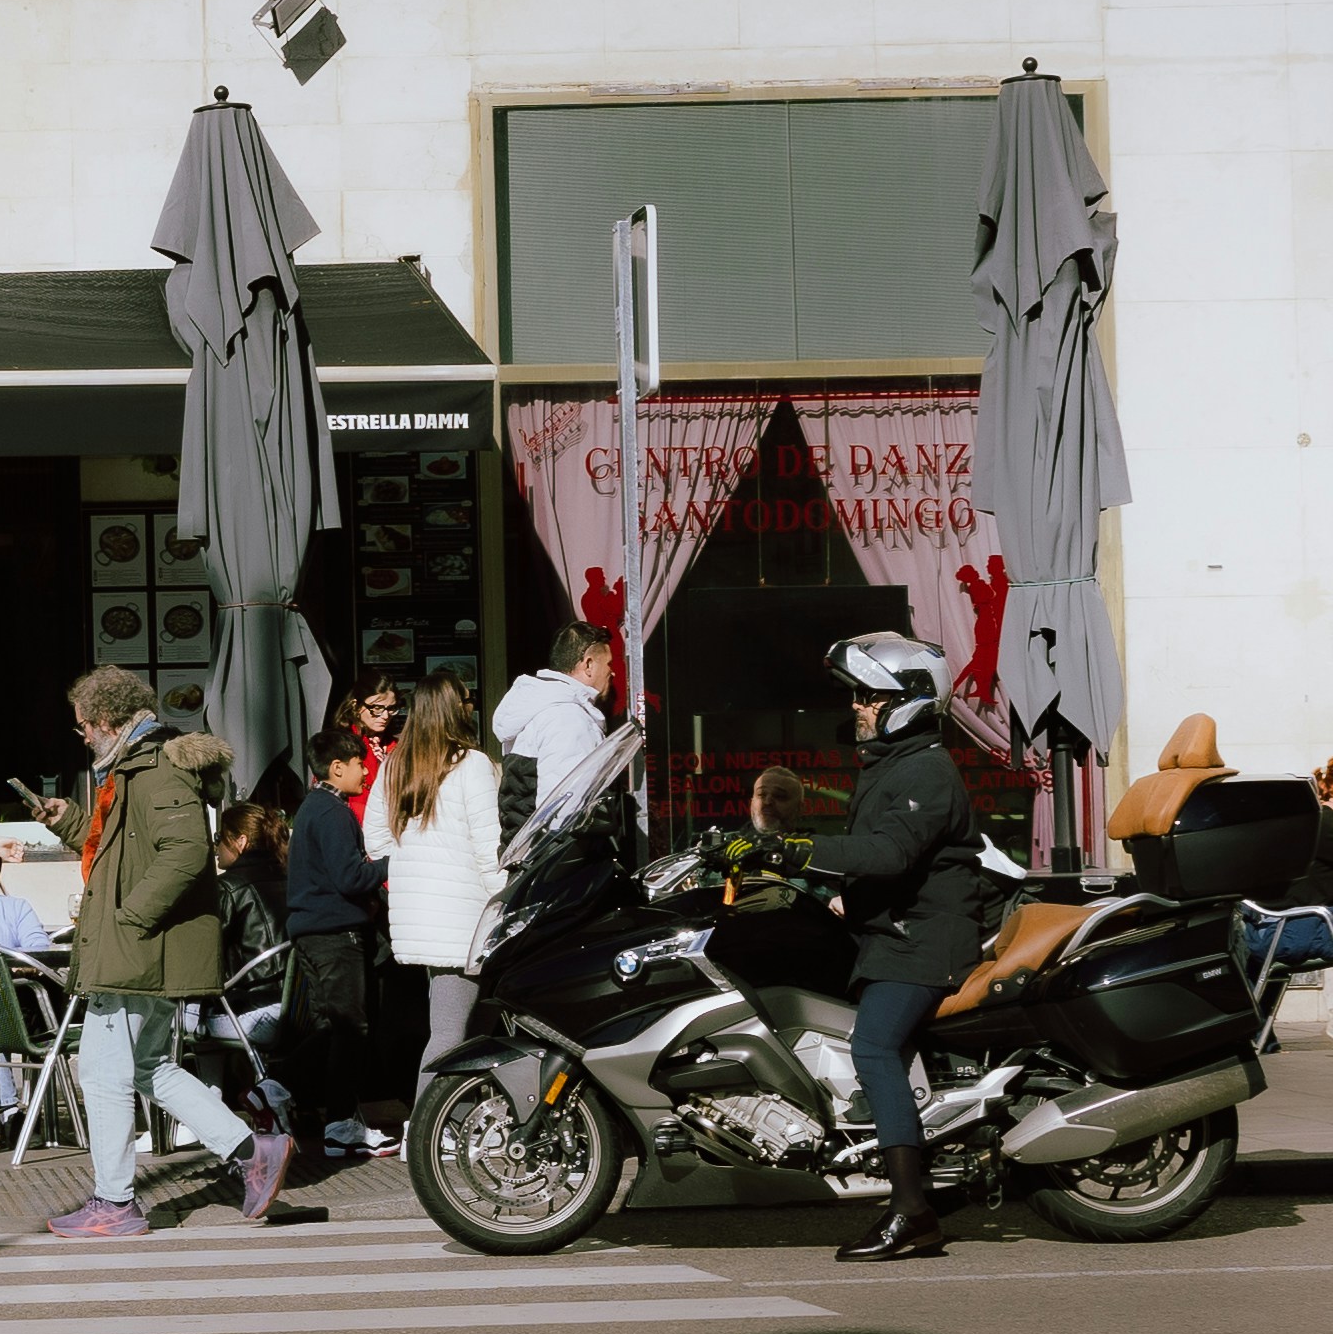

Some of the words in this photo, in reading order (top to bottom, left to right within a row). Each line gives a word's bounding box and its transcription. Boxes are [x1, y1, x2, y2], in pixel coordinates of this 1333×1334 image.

[326, 413, 412, 430] ESTRELLA
[414, 413, 469, 429] DAMM
[777, 444, 832, 478] DE
[849, 443, 971, 476] DANZ
[669, 752, 717, 770] CON
[724, 750, 842, 770] NUESTRAS
[801, 773, 855, 791] HATA
[1202, 968, 1222, 979] BMW
